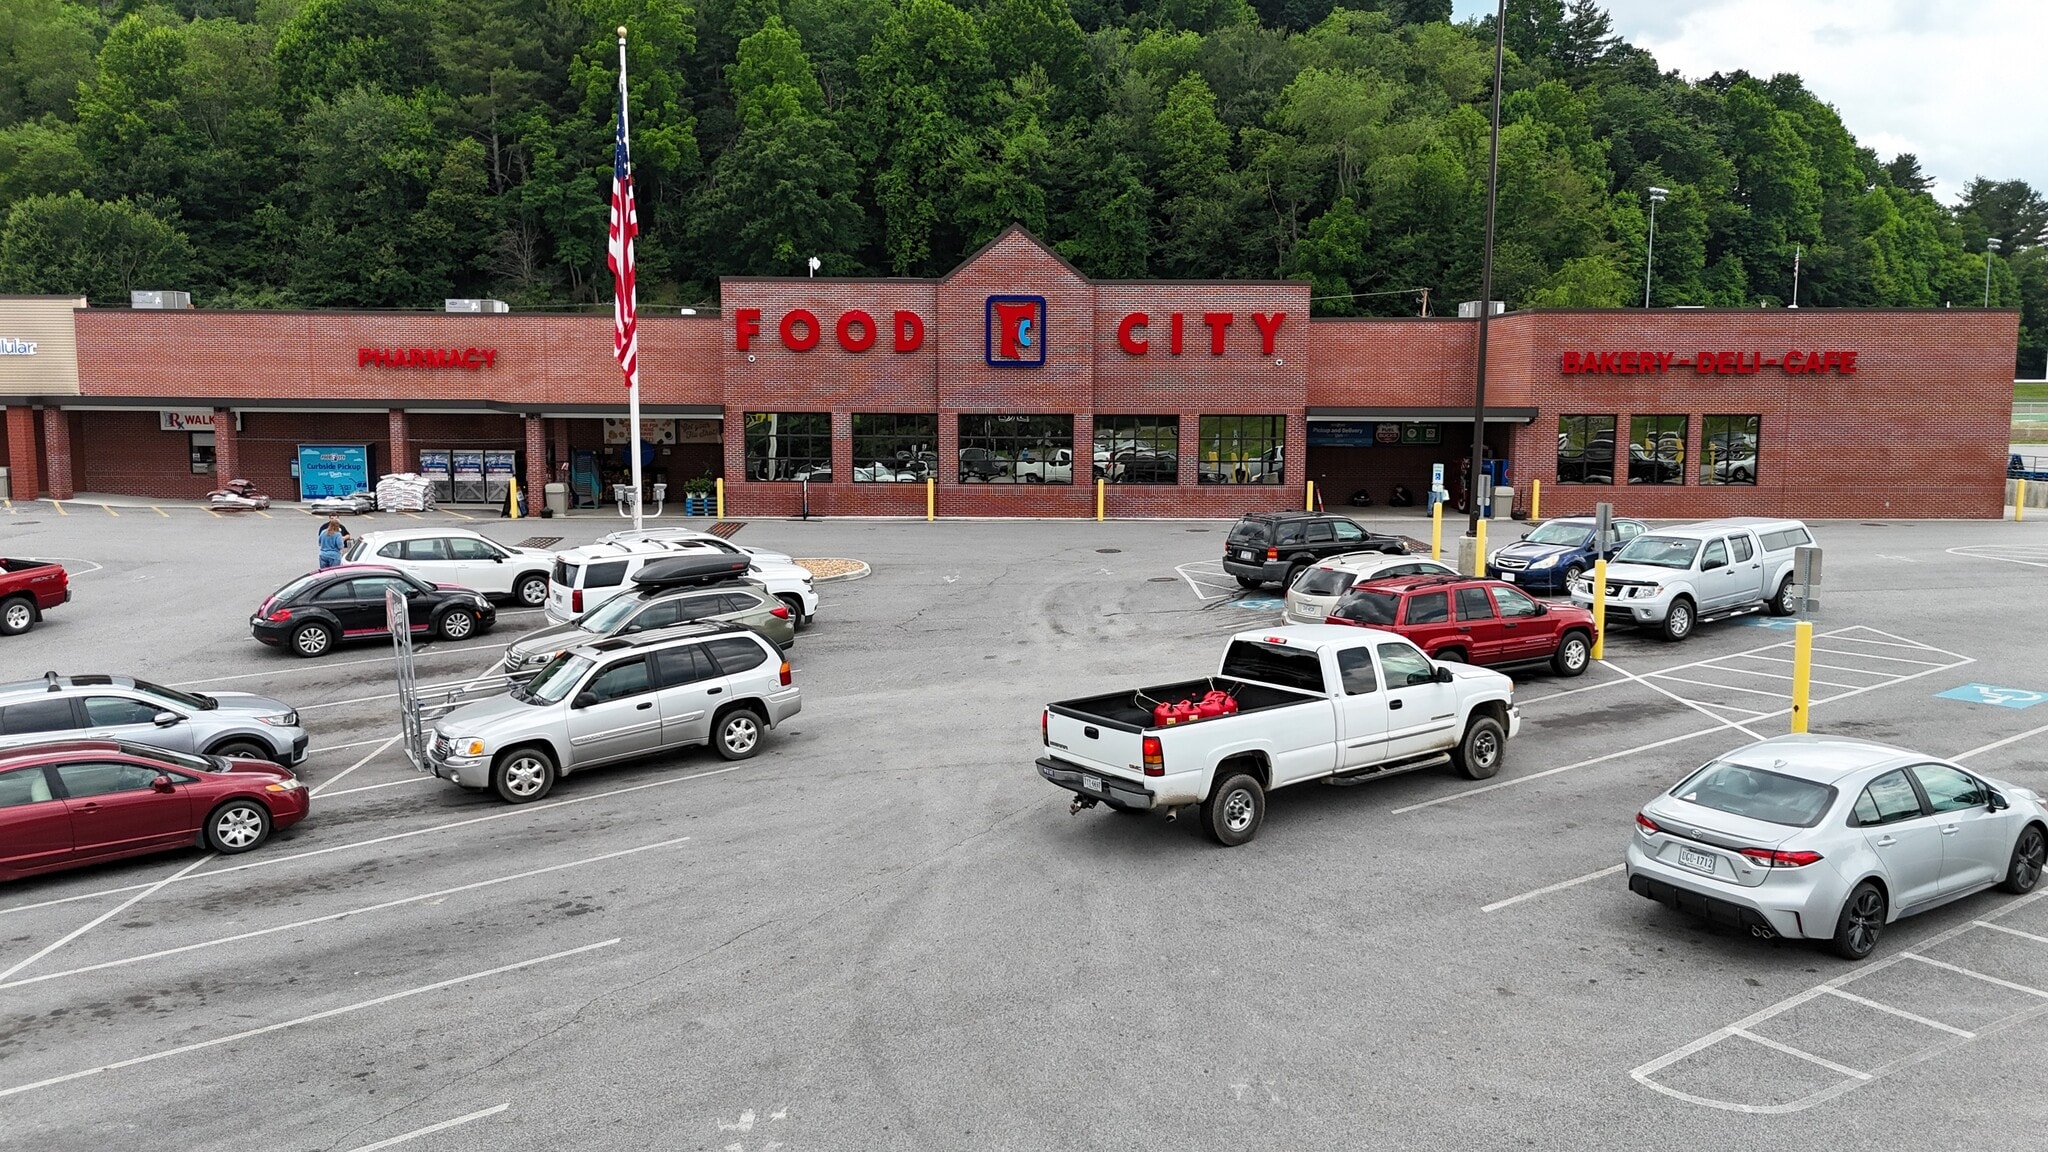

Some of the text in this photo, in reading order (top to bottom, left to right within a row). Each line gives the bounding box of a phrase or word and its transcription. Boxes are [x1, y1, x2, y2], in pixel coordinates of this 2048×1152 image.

[735, 308, 1287, 355] FOOD CITY
[0, 339, 34, 354] lular
[358, 349, 498, 369] PHARMACY
[1562, 351, 1674, 374] BAKERY
[1696, 351, 1761, 374] DELI
[1783, 350, 1858, 374] CAFE
